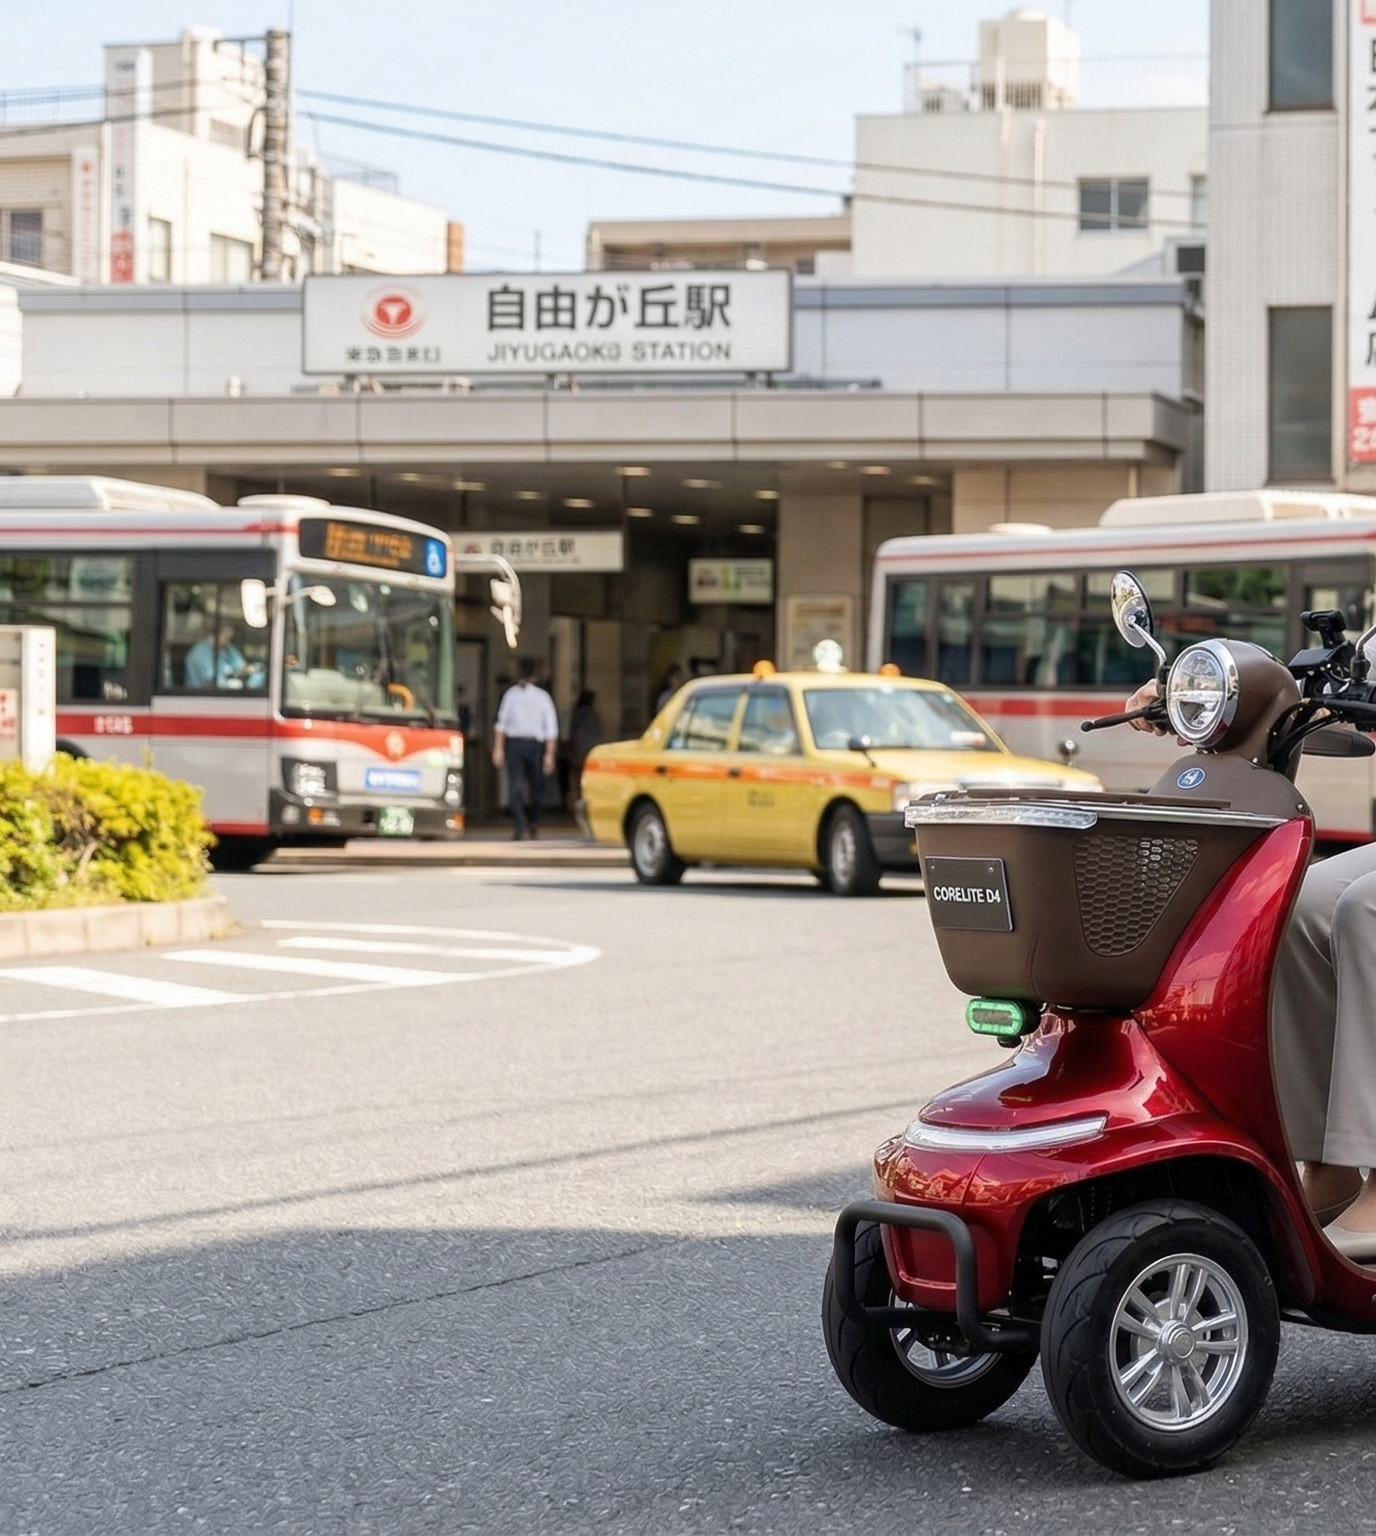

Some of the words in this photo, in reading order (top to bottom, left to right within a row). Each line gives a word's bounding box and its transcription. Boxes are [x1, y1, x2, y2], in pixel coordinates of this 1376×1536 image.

[487, 283, 731, 331] 自由が丘駅
[632, 340, 731, 361] STATION
[933, 886, 985, 903] CORELITE
[985, 888, 1001, 903] D4
